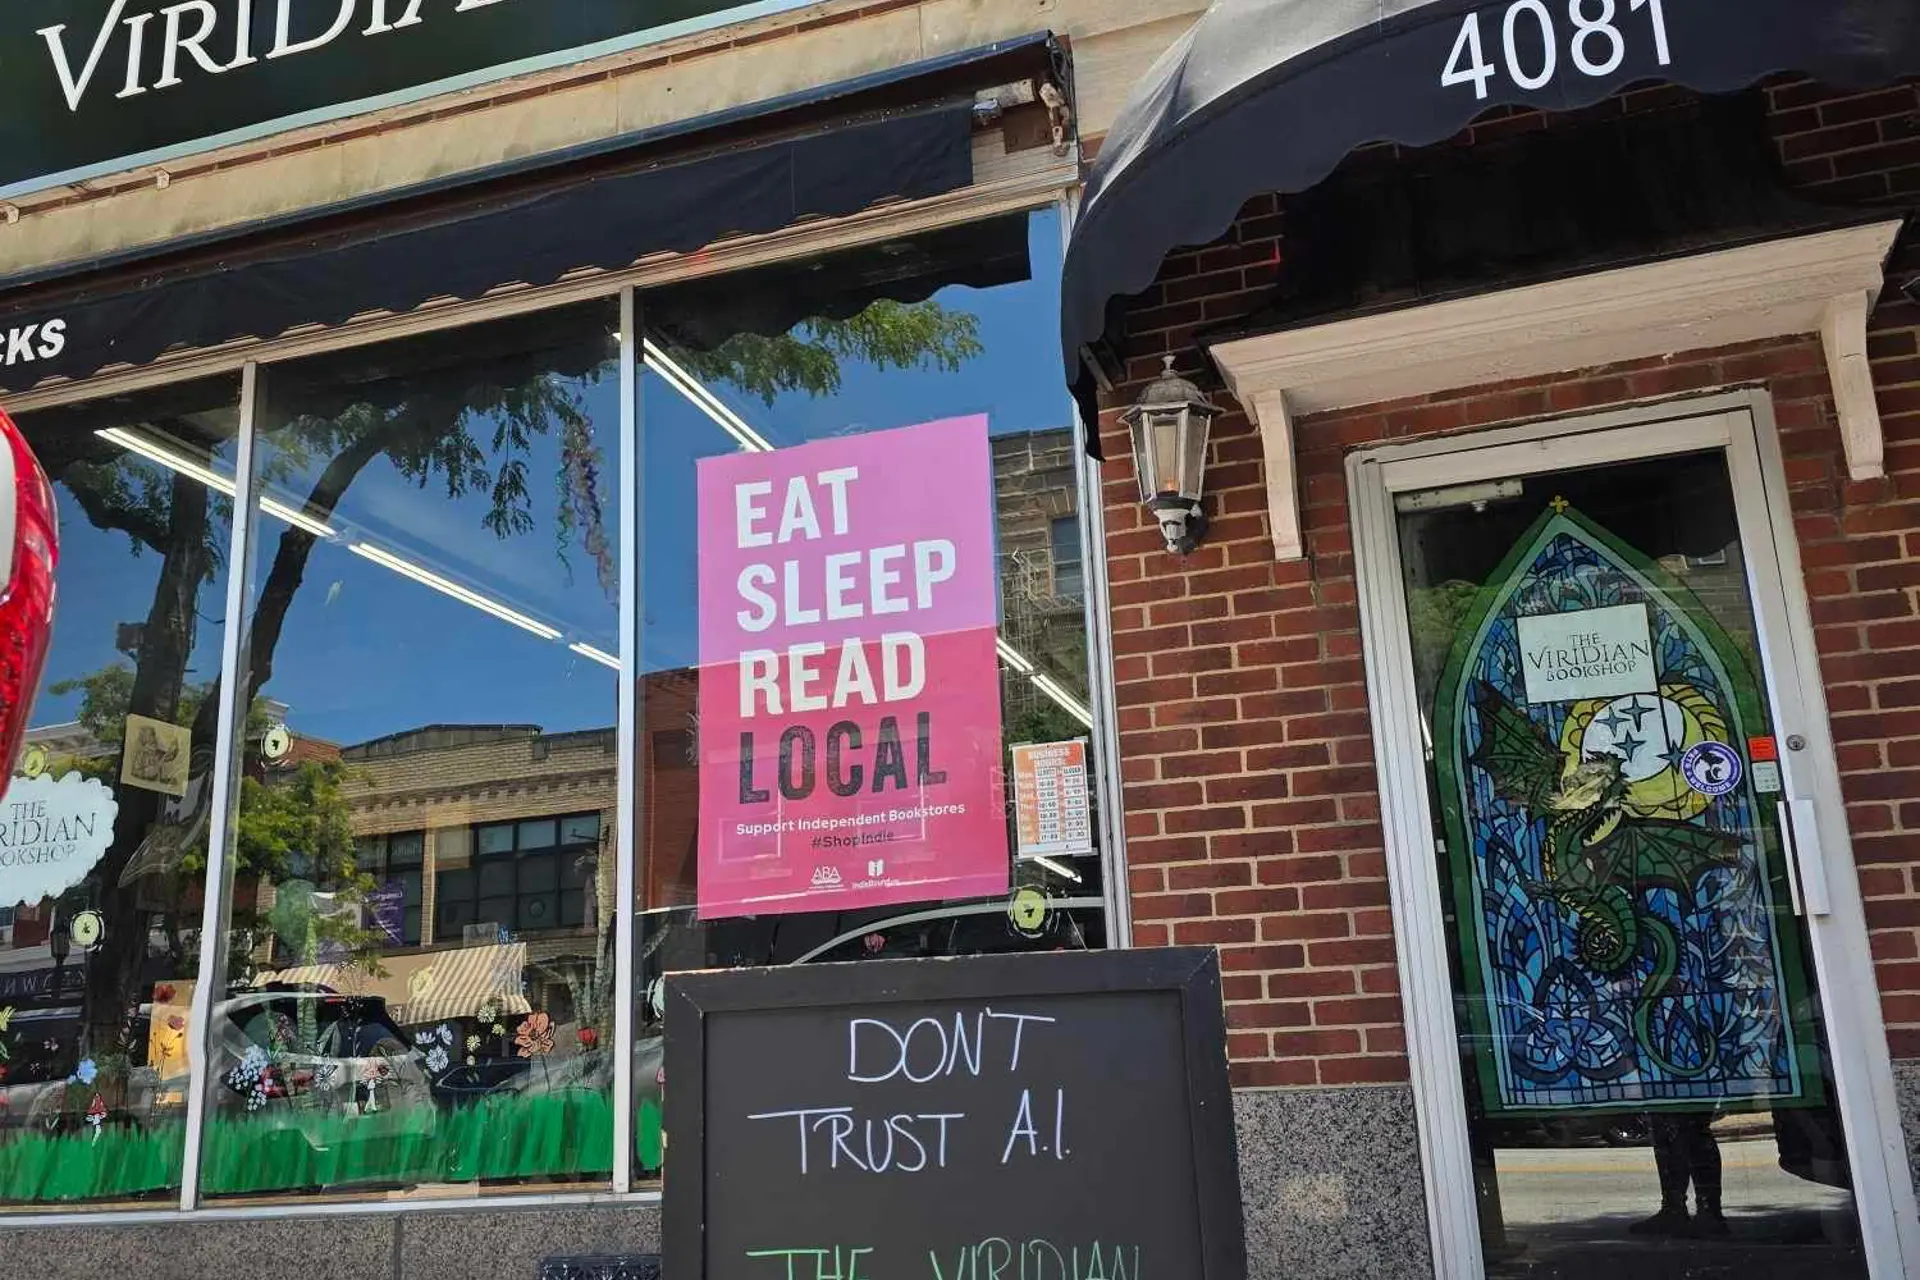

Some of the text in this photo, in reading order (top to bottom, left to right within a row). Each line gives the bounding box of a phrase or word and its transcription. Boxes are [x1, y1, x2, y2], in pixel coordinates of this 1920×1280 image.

[1441, 0, 1671, 100] 4081
[735, 466, 859, 549] EAT
[737, 539, 956, 632] SLEEP
[739, 631, 925, 718] READ
[1528, 639, 1649, 670] VIRIDIAN
[1546, 660, 1637, 682] BOOKSHOP
[1568, 632, 1600, 647] THE
[739, 712, 947, 804] LOCAL
[10, 800, 47, 820] THE
[736, 803, 965, 836] Support Independent Bookstores
[812, 830, 894, 849] #ShopIndie
[848, 1008, 1055, 1083] DON'T
[747, 1089, 1072, 1175] TRUST A.I.
